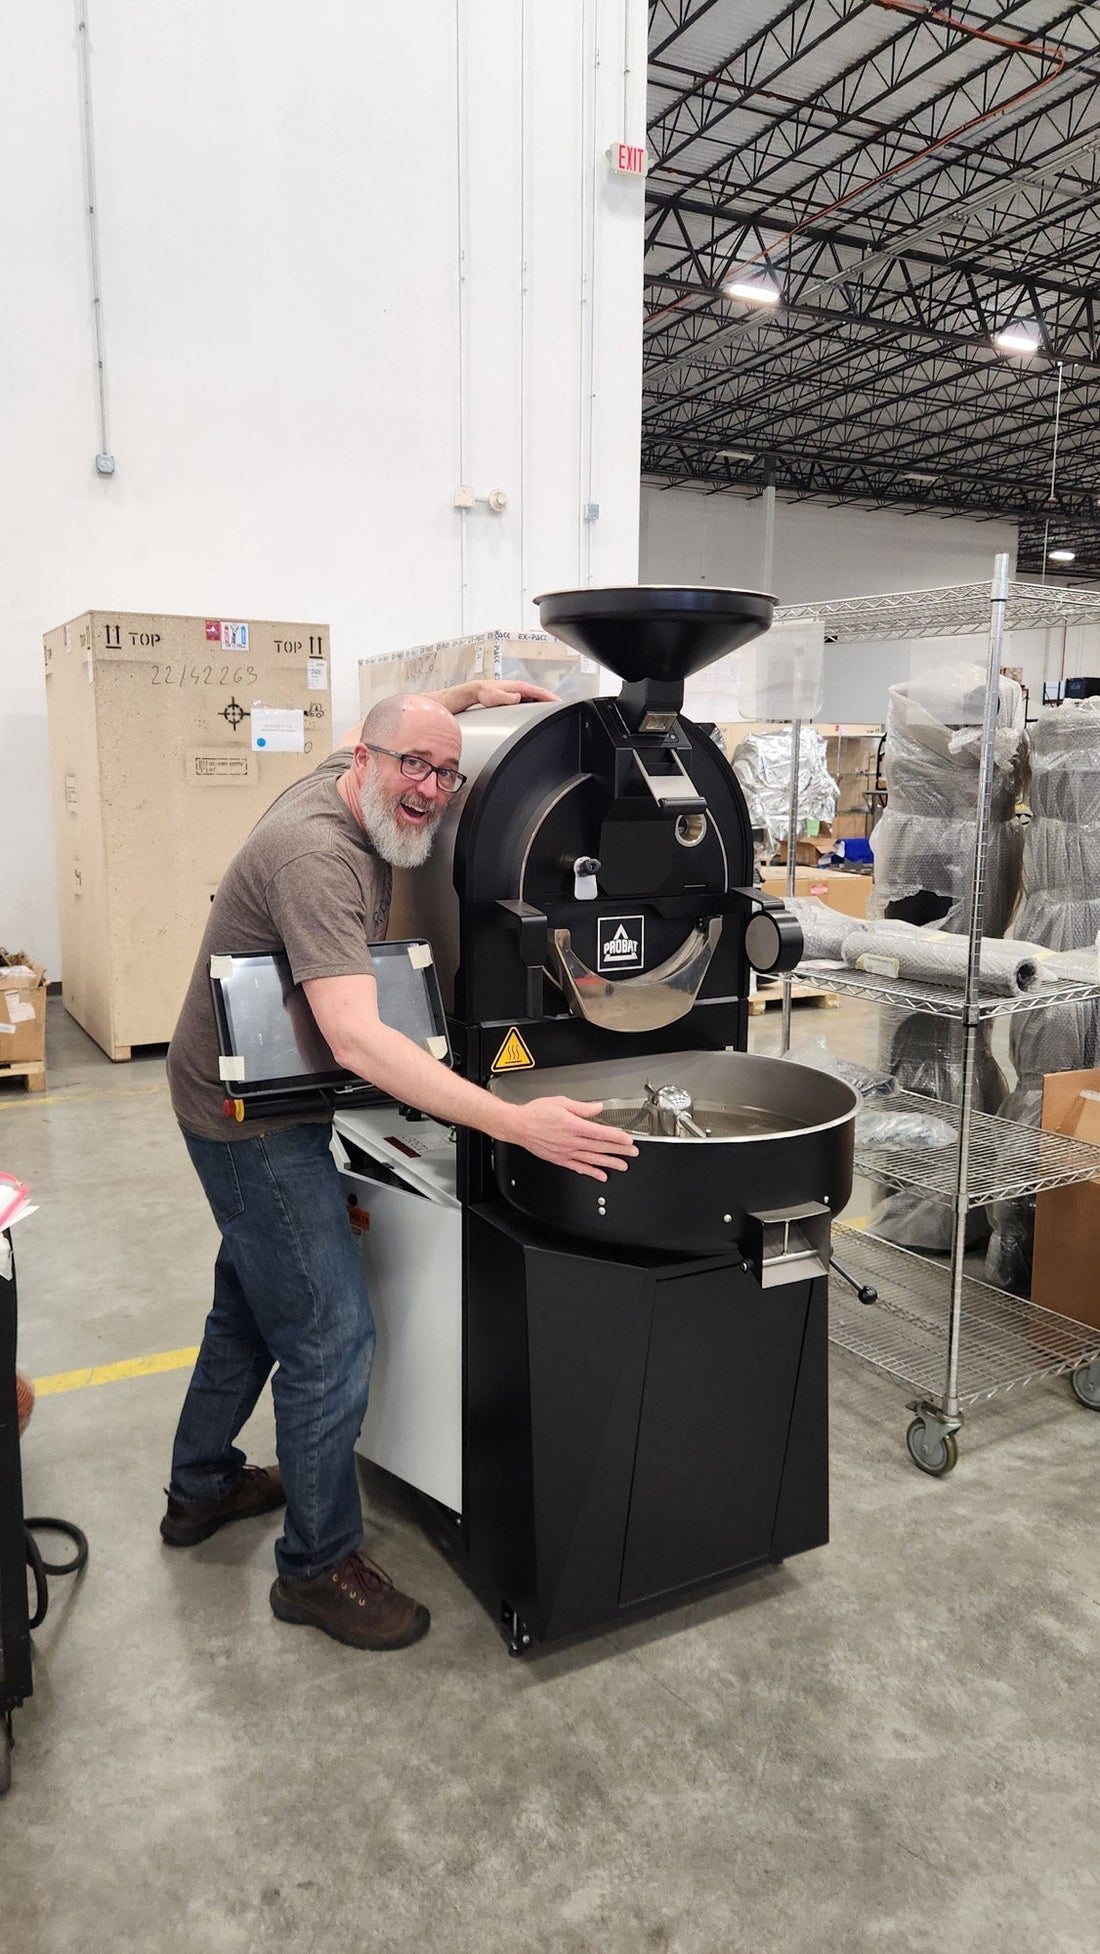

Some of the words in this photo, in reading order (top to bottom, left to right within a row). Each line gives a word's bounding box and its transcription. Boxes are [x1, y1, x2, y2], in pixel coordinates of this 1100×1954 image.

[618, 144, 644, 173] EXIT
[128, 631, 161, 647] TOP
[273, 640, 303, 654] TOP
[603, 938, 639, 955] PROBAT
